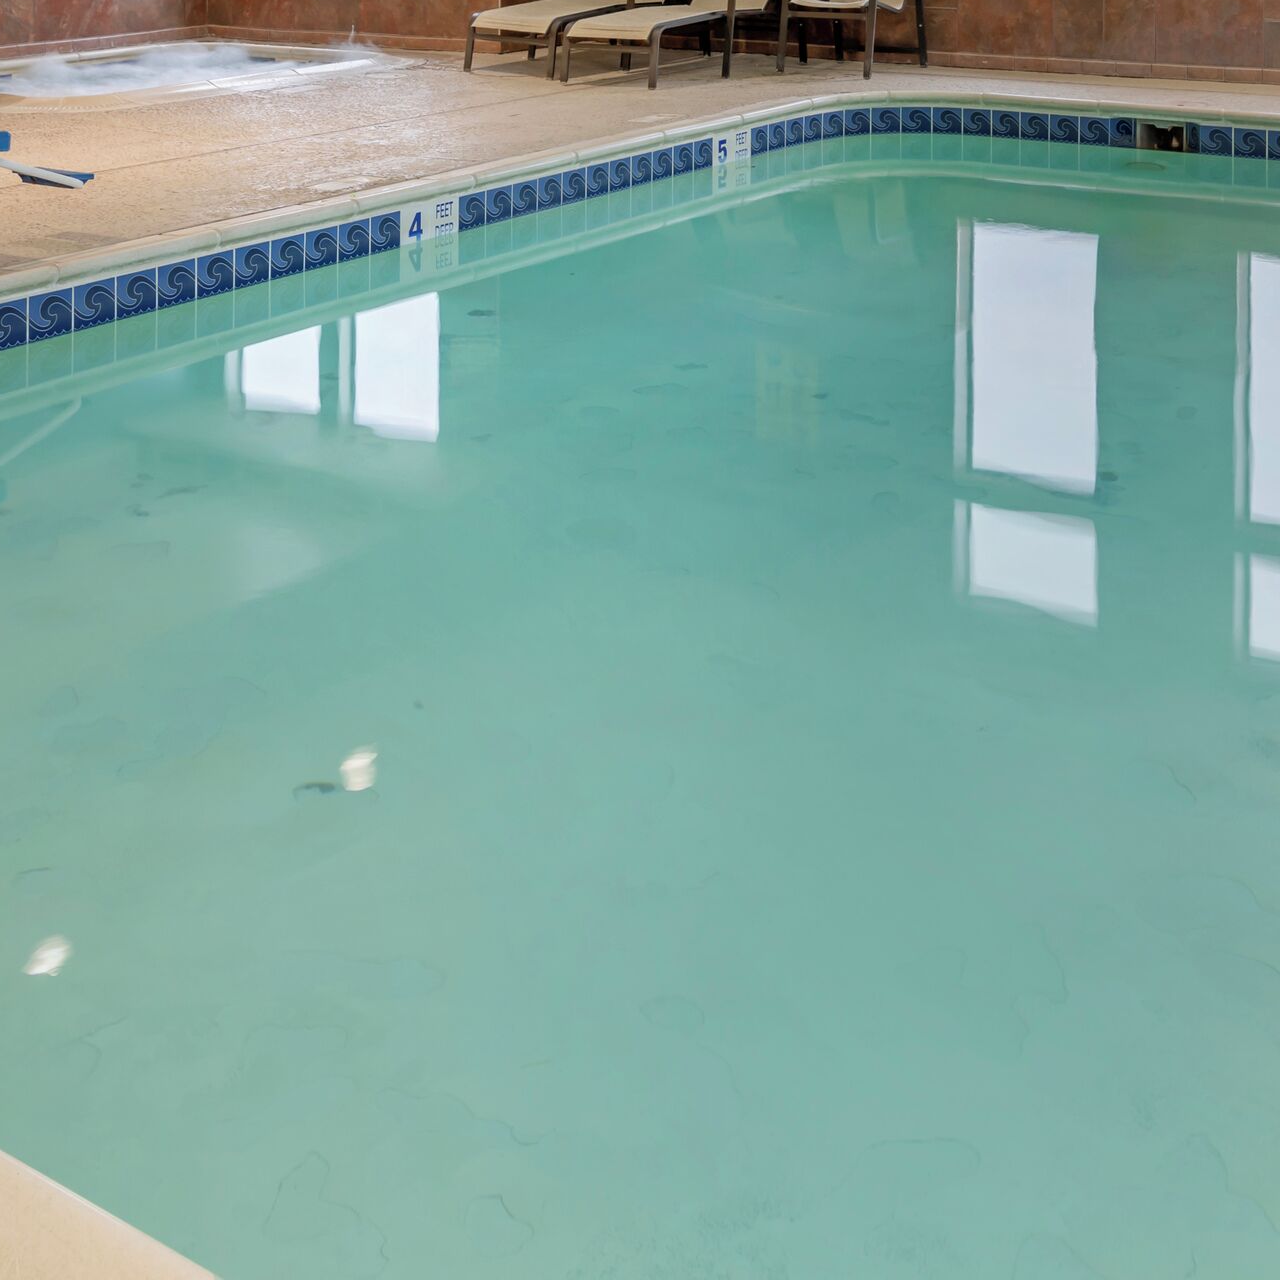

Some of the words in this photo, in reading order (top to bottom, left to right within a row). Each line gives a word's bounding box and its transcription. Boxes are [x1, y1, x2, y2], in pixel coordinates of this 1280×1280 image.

[718, 139, 728, 163] 5
[436, 201, 453, 219] FEET
[408, 211, 423, 241] 4
